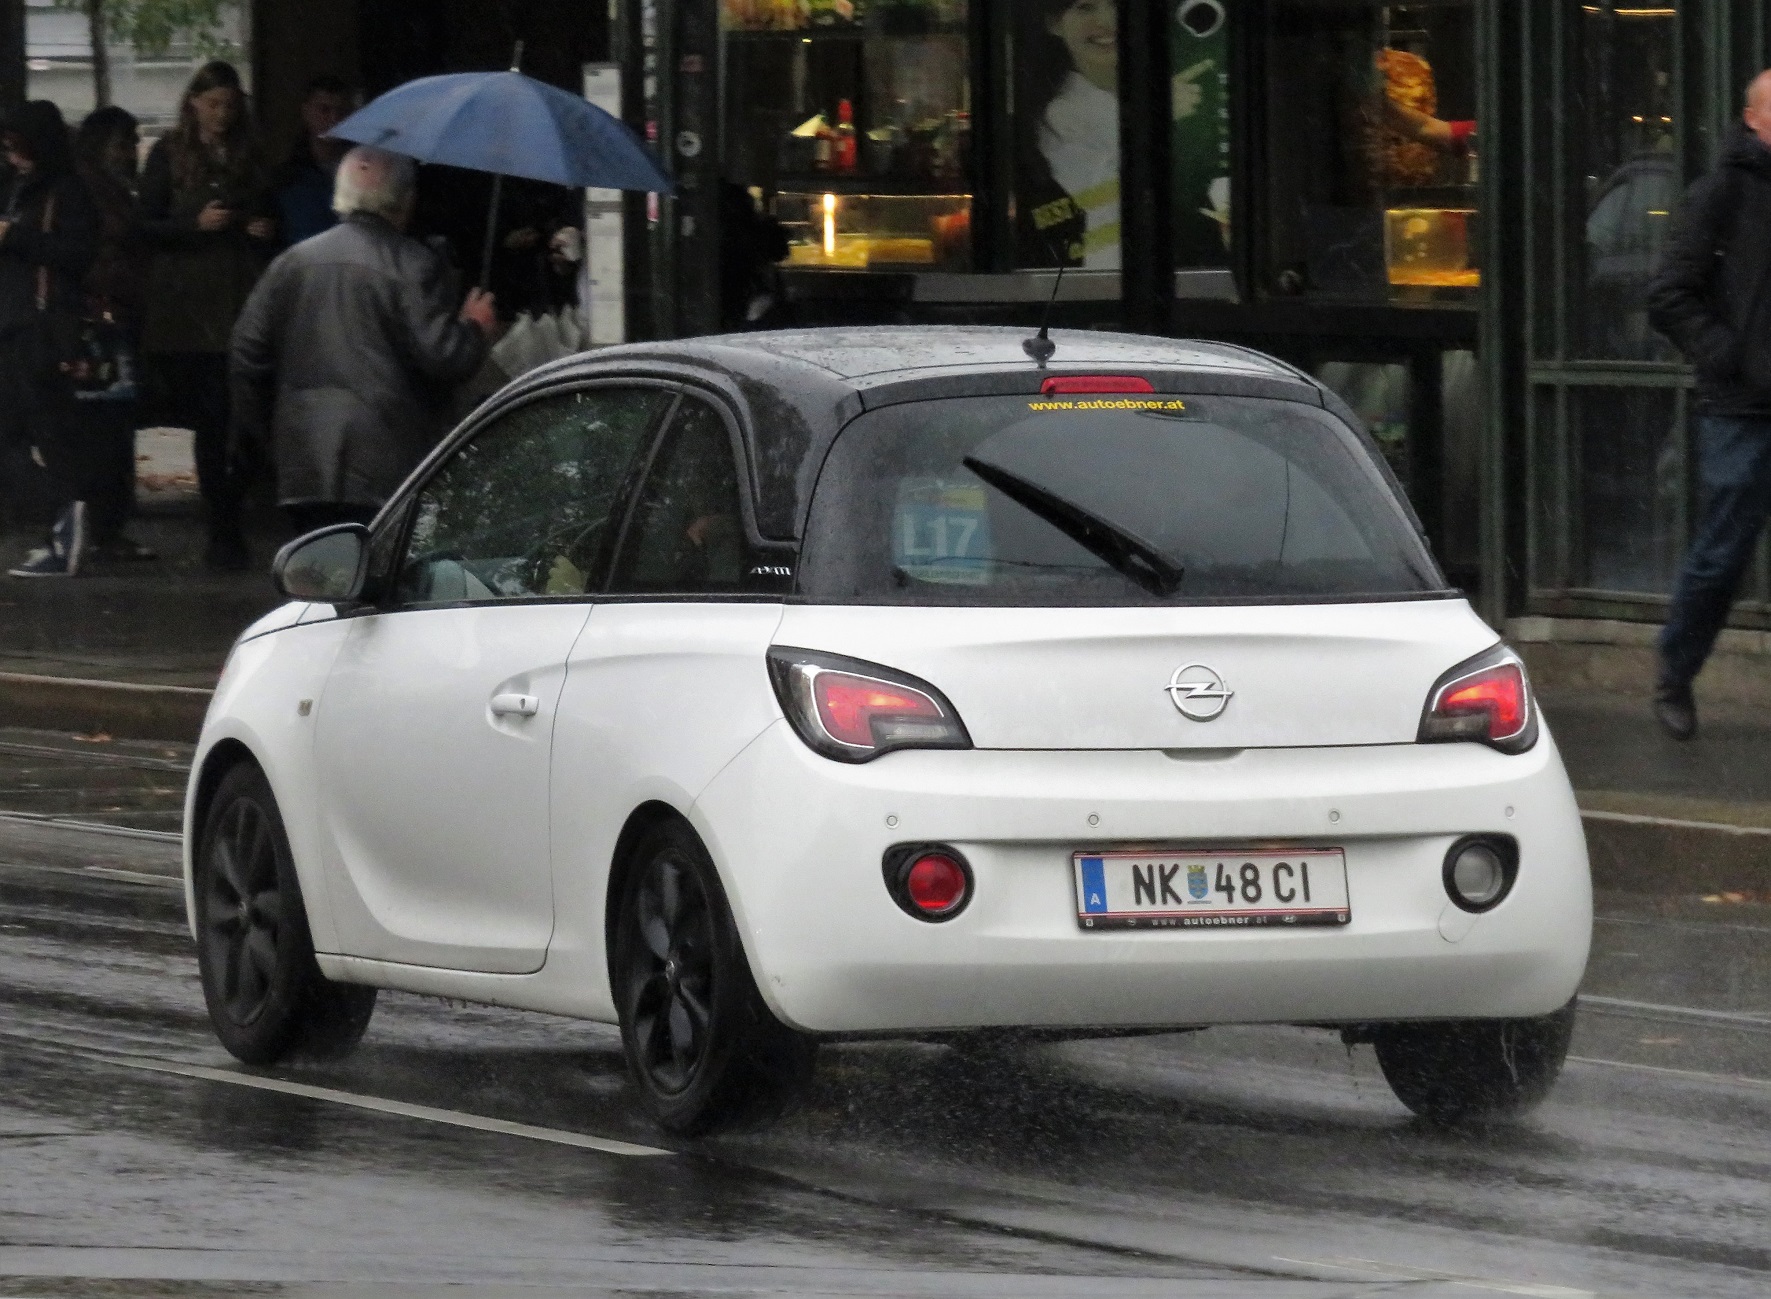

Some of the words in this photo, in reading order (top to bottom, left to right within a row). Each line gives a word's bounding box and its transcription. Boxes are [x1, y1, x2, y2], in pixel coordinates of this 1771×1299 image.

[1029, 399, 1185, 411] www.autoebner.at
[903, 513, 978, 556] L17
[1132, 863, 1183, 906] NK
[1214, 863, 1262, 904] 48
[1090, 892, 1101, 906] A
